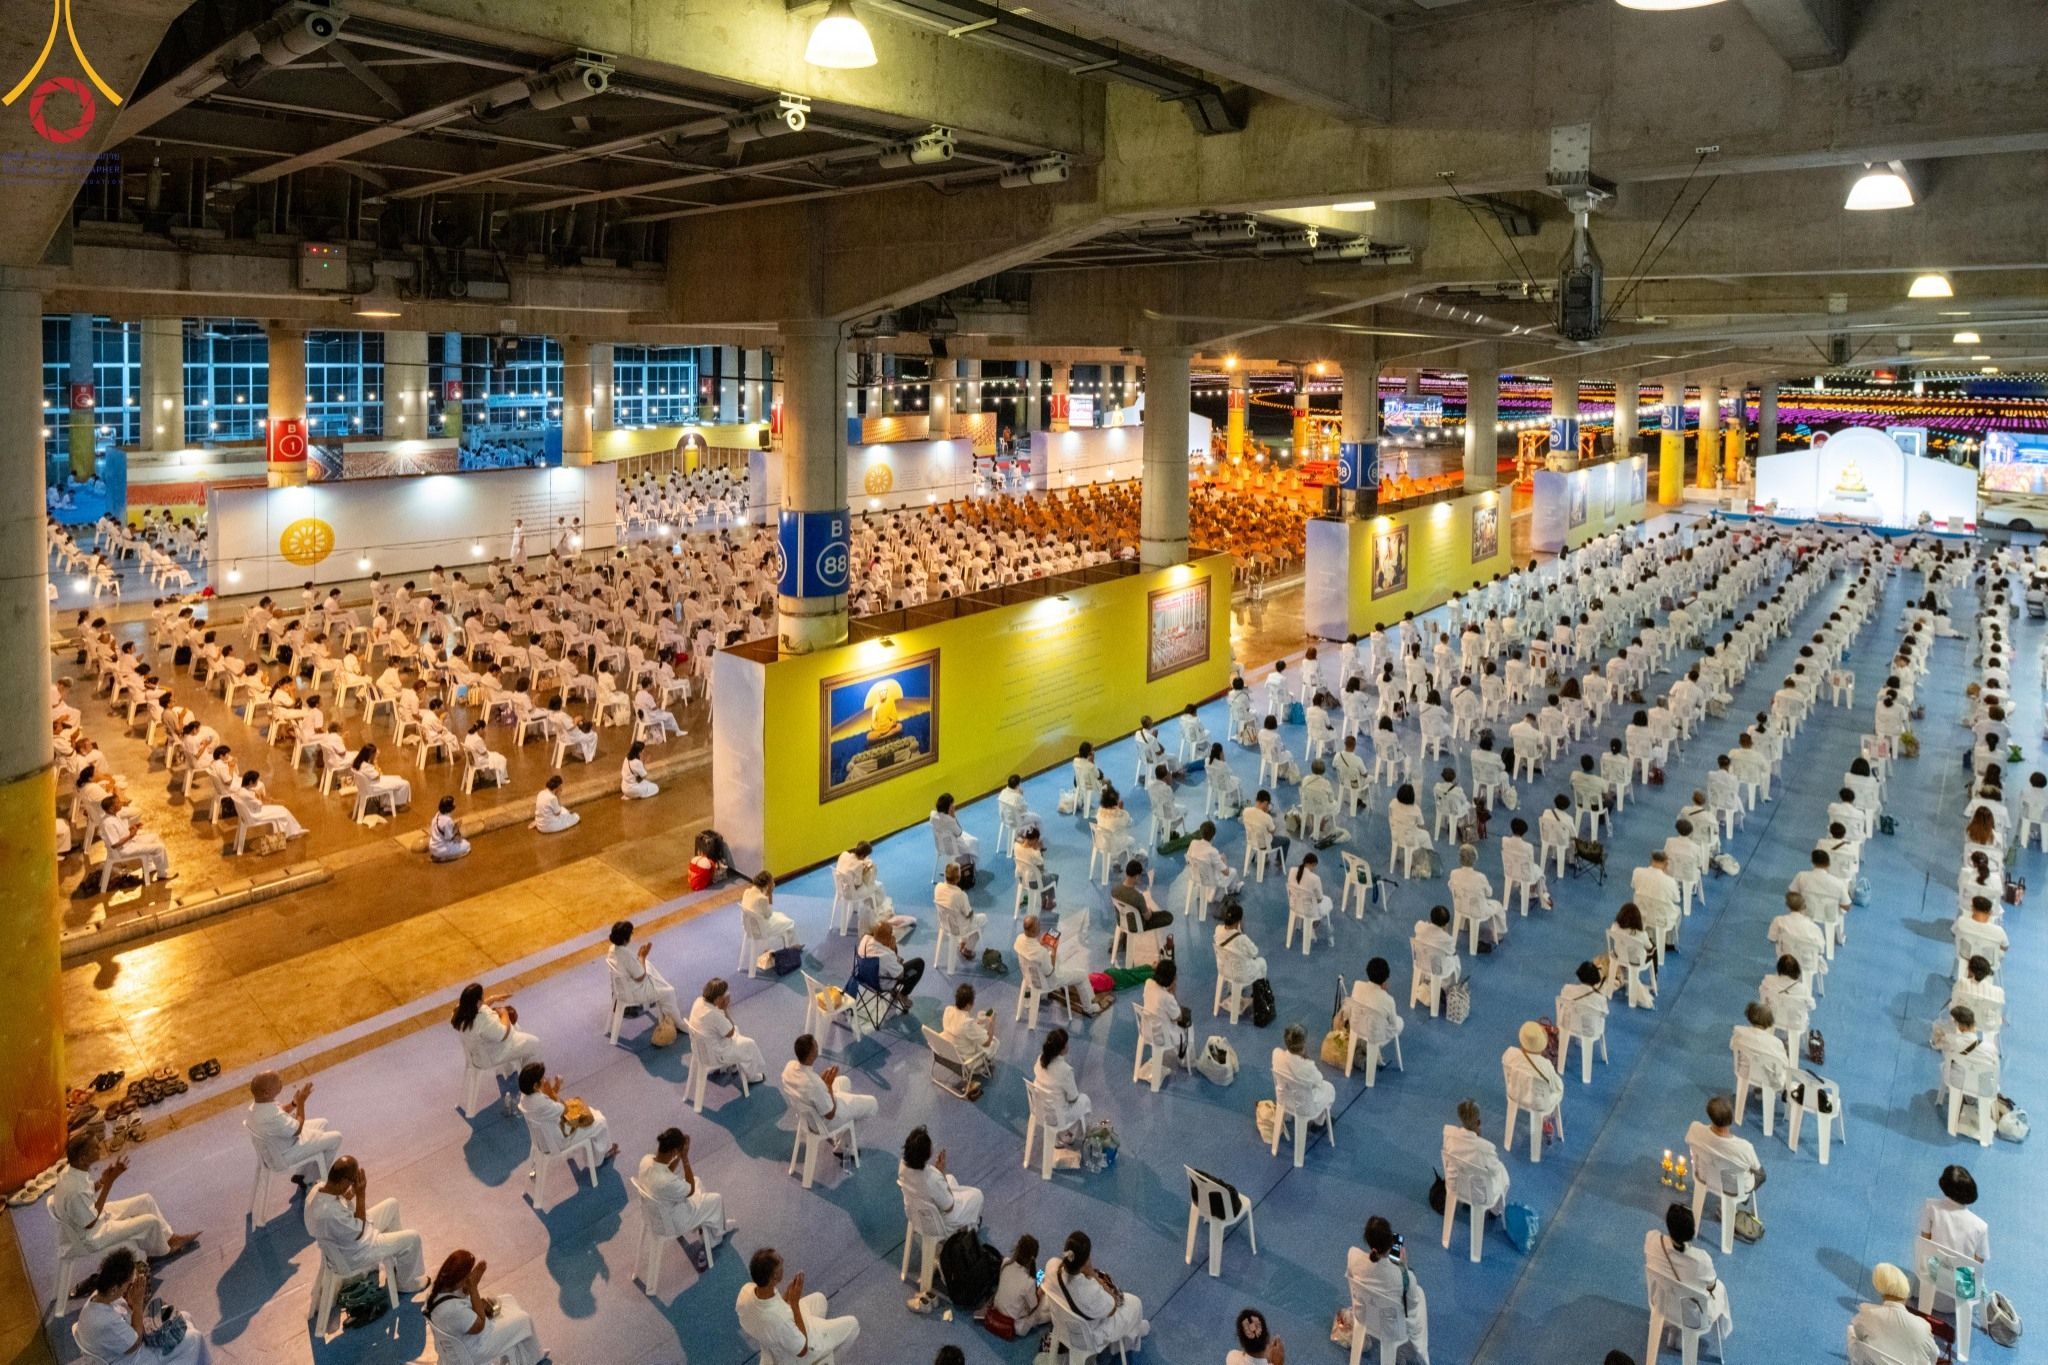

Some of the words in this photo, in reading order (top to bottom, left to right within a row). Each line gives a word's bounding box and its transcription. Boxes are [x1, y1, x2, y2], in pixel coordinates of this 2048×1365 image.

[288, 424, 296, 433] B
[291, 441, 296, 450] 1
[831, 519, 843, 539] B
[824, 554, 847, 574] 88
